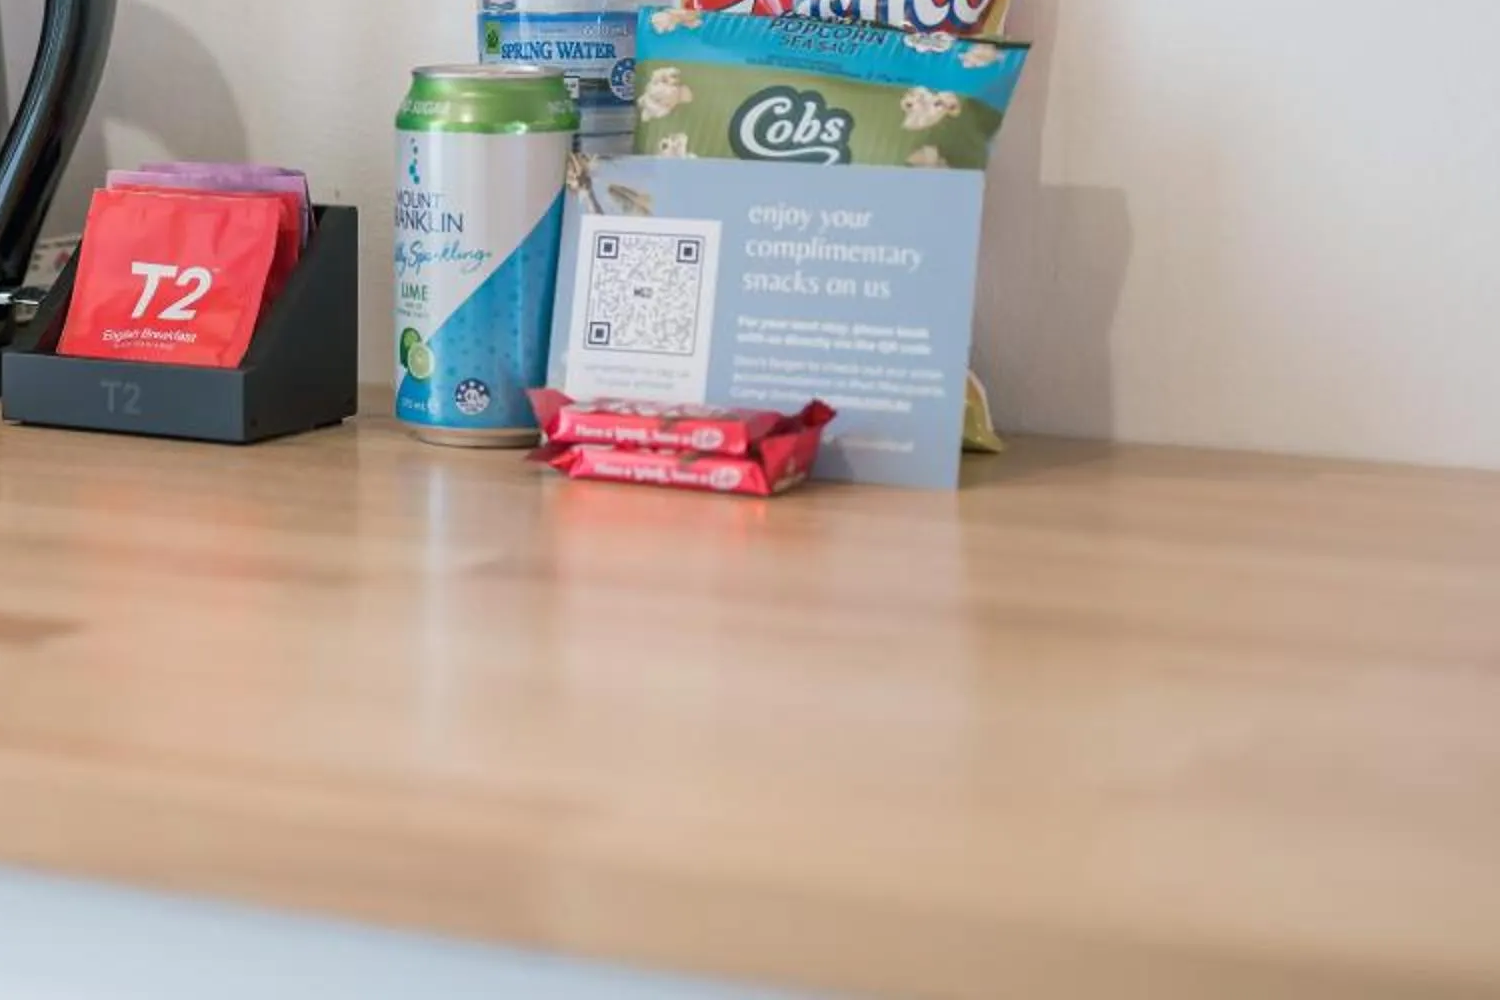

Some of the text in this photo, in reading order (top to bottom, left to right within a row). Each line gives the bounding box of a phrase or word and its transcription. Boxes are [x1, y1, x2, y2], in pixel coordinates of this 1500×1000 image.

[772, 19, 887, 45] POPCORN
[780, 35, 859, 55] SEA SALT
[501, 41, 616, 60] SPRING WATER
[739, 96, 847, 163] Cobs
[748, 201, 873, 234] enjoy your
[745, 236, 922, 273] complimentary
[131, 261, 213, 320] T2
[742, 271, 891, 299] snacks on us
[100, 381, 142, 416] T2
